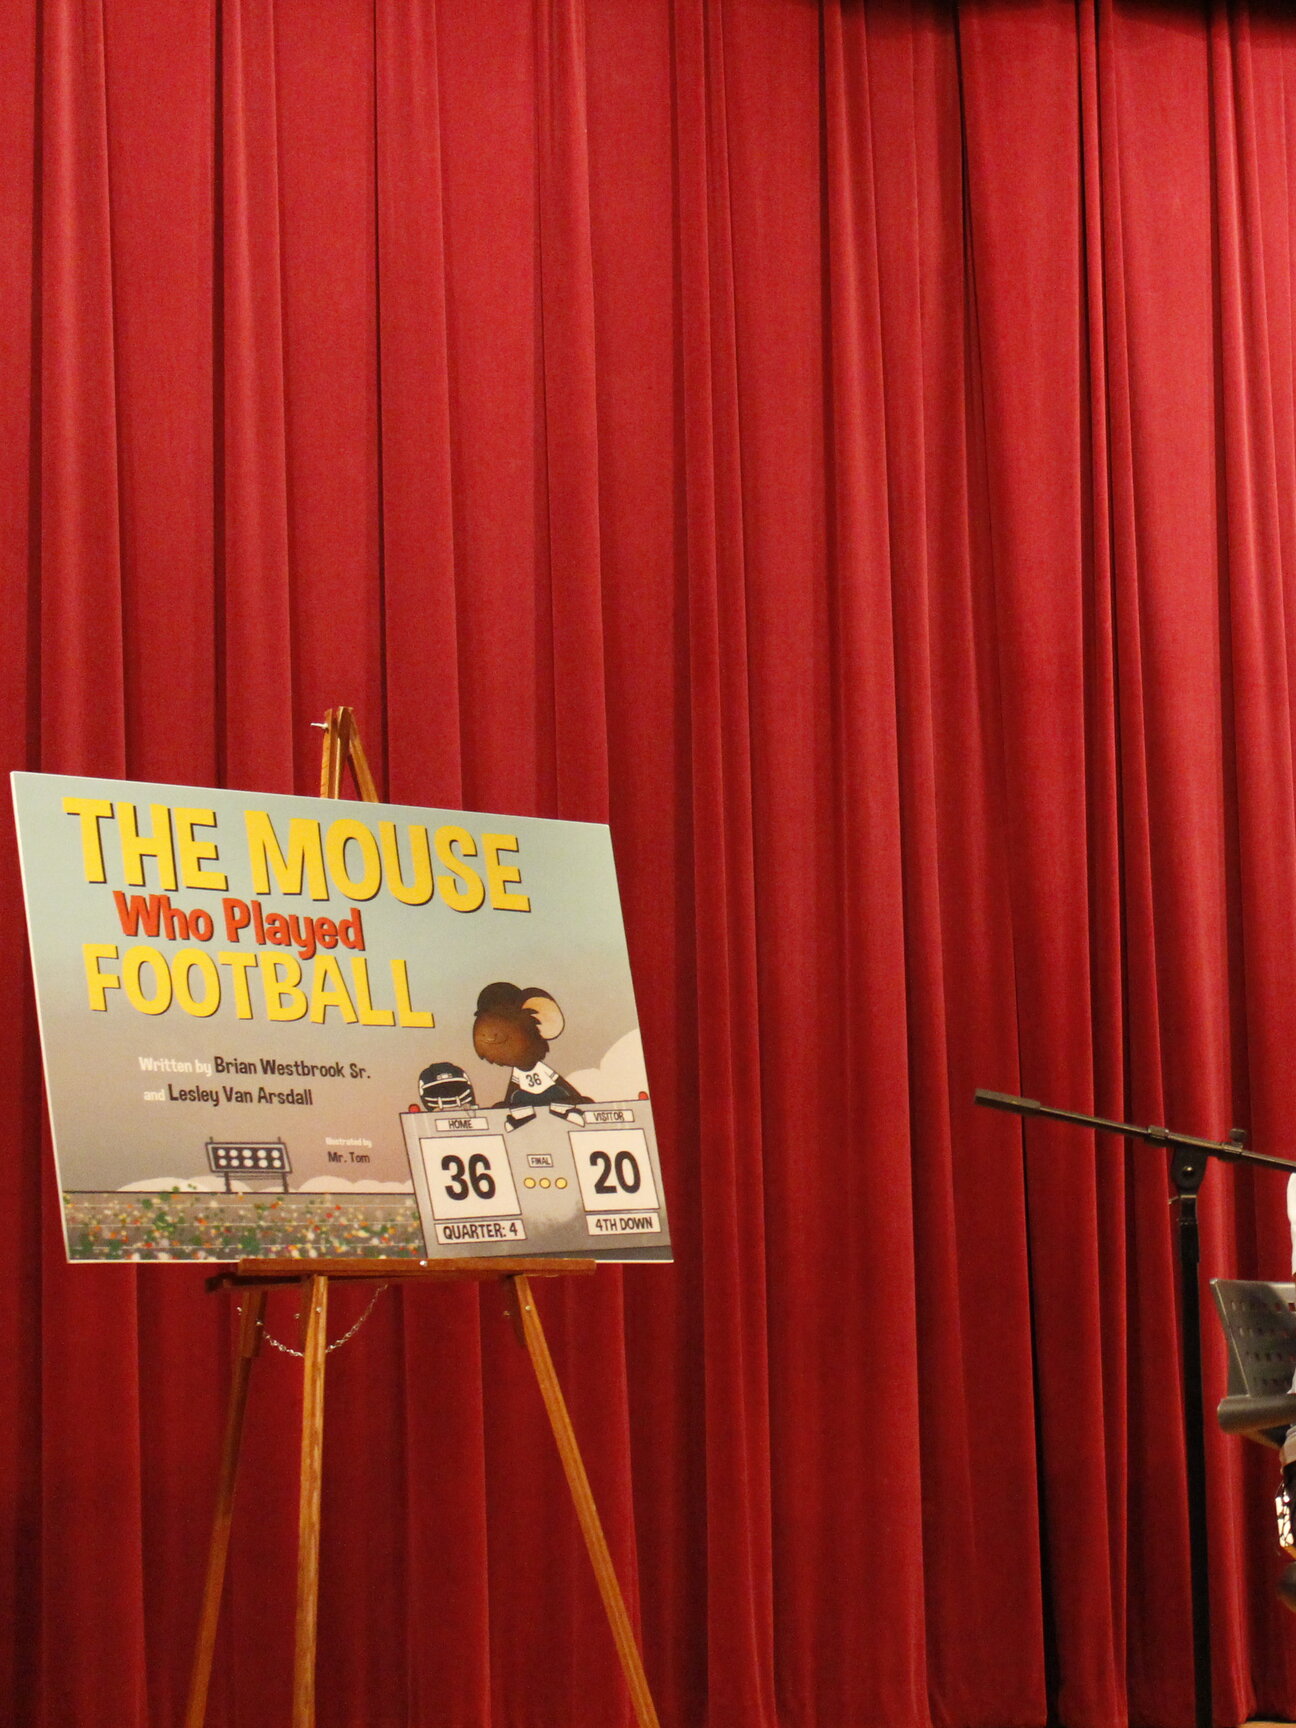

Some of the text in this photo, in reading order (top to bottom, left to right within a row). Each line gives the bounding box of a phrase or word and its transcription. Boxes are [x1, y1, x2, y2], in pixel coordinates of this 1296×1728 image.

[62, 797, 531, 913] THE MOUSE
[113, 890, 365, 959] Who Played
[82, 943, 435, 1028] FOOTBALL
[138, 1056, 371, 1079] Written by Brian Westbrook Sr.
[525, 1073, 542, 1087] 36
[143, 1083, 313, 1107] and Lesley Van Arsdall
[448, 1119, 473, 1129] HOME
[593, 1111, 624, 1122] VISITOR
[327, 1151, 371, 1163] Mr. Tom
[441, 1153, 496, 1201] 36
[589, 1150, 641, 1194] 20
[443, 1221, 518, 1240] QUARTER: 4
[595, 1213, 653, 1231] 4TH DOWN
